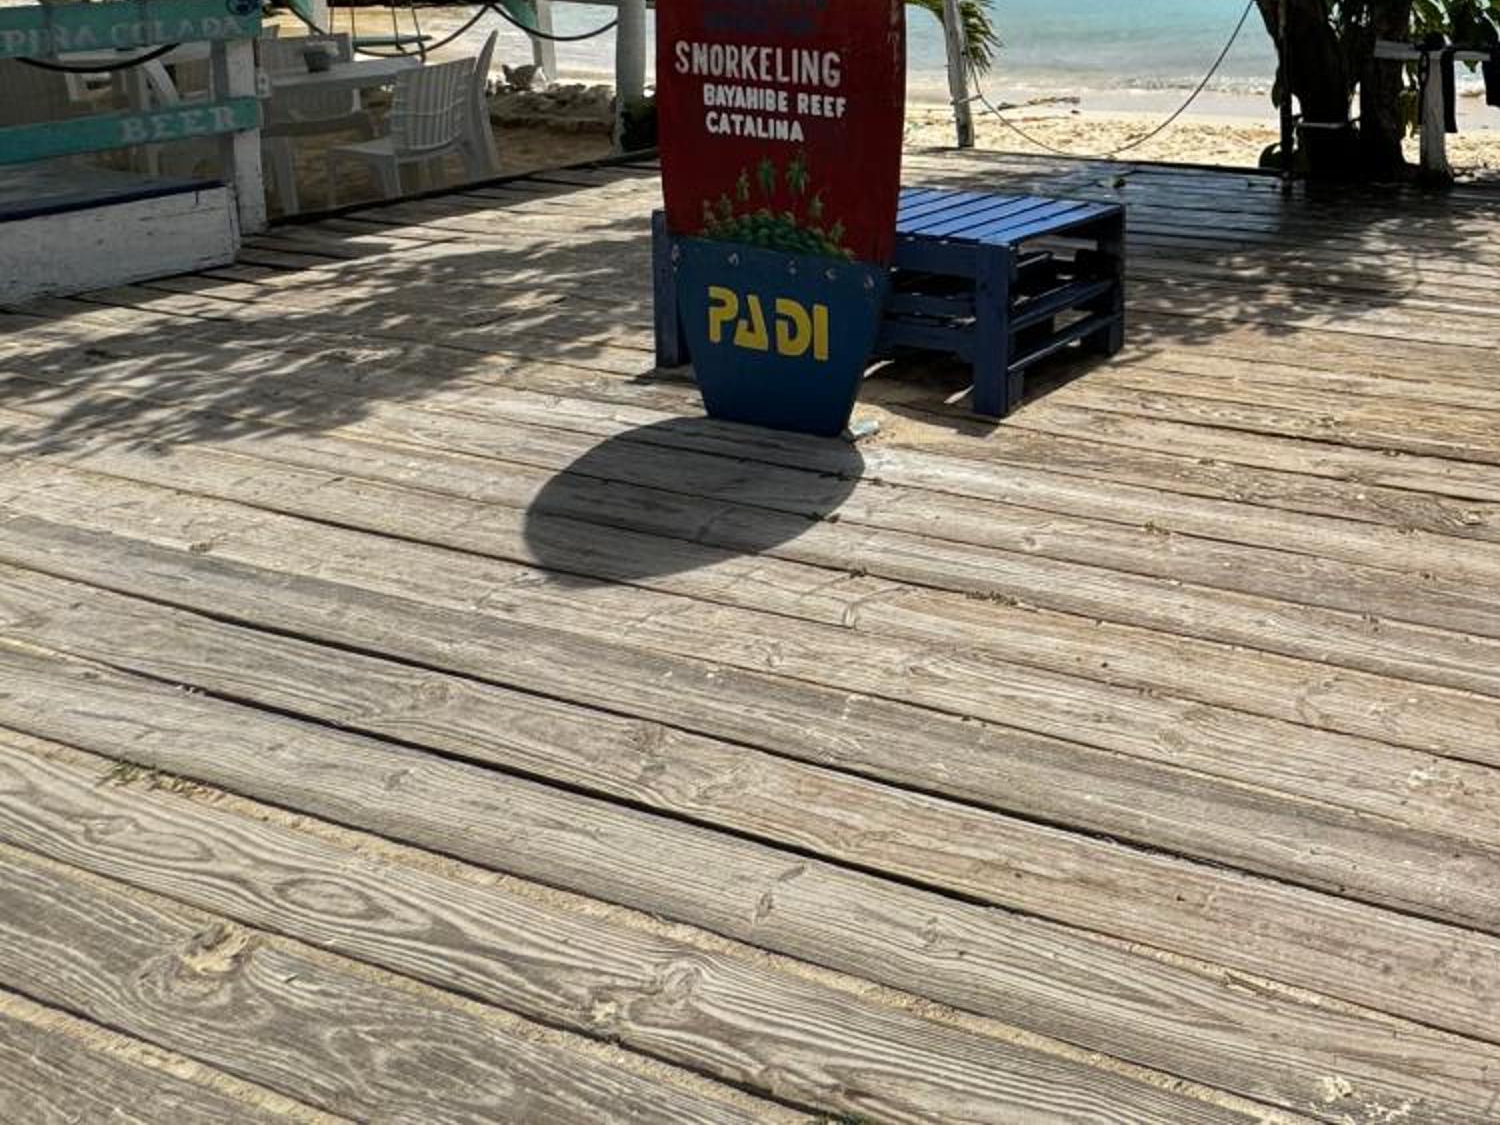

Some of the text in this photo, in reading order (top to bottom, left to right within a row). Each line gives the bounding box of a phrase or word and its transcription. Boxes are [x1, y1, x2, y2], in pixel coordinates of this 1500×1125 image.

[112, 13, 243, 46] COLADA
[675, 40, 842, 88] SNORKELING
[703, 83, 847, 119] BAYAHIBE REEF
[121, 104, 236, 141] BEER
[705, 112, 804, 142] CATALINA
[708, 286, 829, 361] PADI
